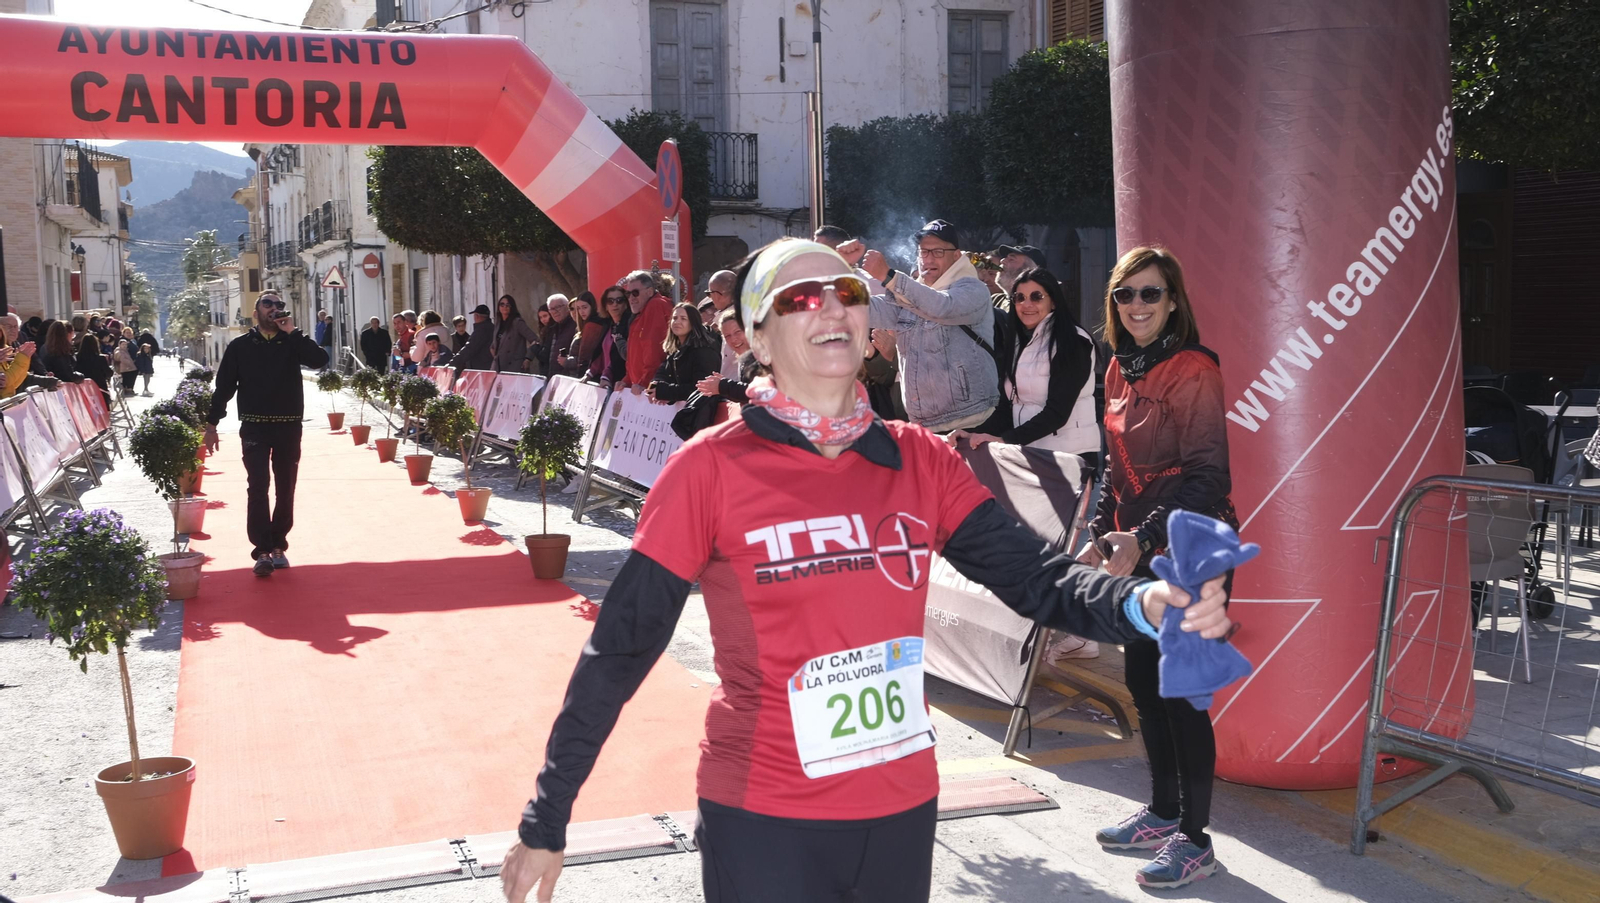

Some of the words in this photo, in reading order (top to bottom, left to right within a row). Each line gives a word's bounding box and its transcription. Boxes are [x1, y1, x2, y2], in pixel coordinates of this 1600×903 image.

[57, 25, 416, 66] AYUNTAMIENTO
[70, 71, 407, 130] CANTORIA
[1225, 105, 1453, 433] www.teamergy.es
[614, 426, 680, 466] CANTORI
[744, 514, 870, 563] TRI
[924, 604, 960, 627] mergy.es
[806, 676, 823, 689] LA
[827, 663, 884, 685] PÓLVORA
[810, 658, 824, 673] IV
[829, 650, 863, 668] CxM
[826, 680, 905, 739] 206
